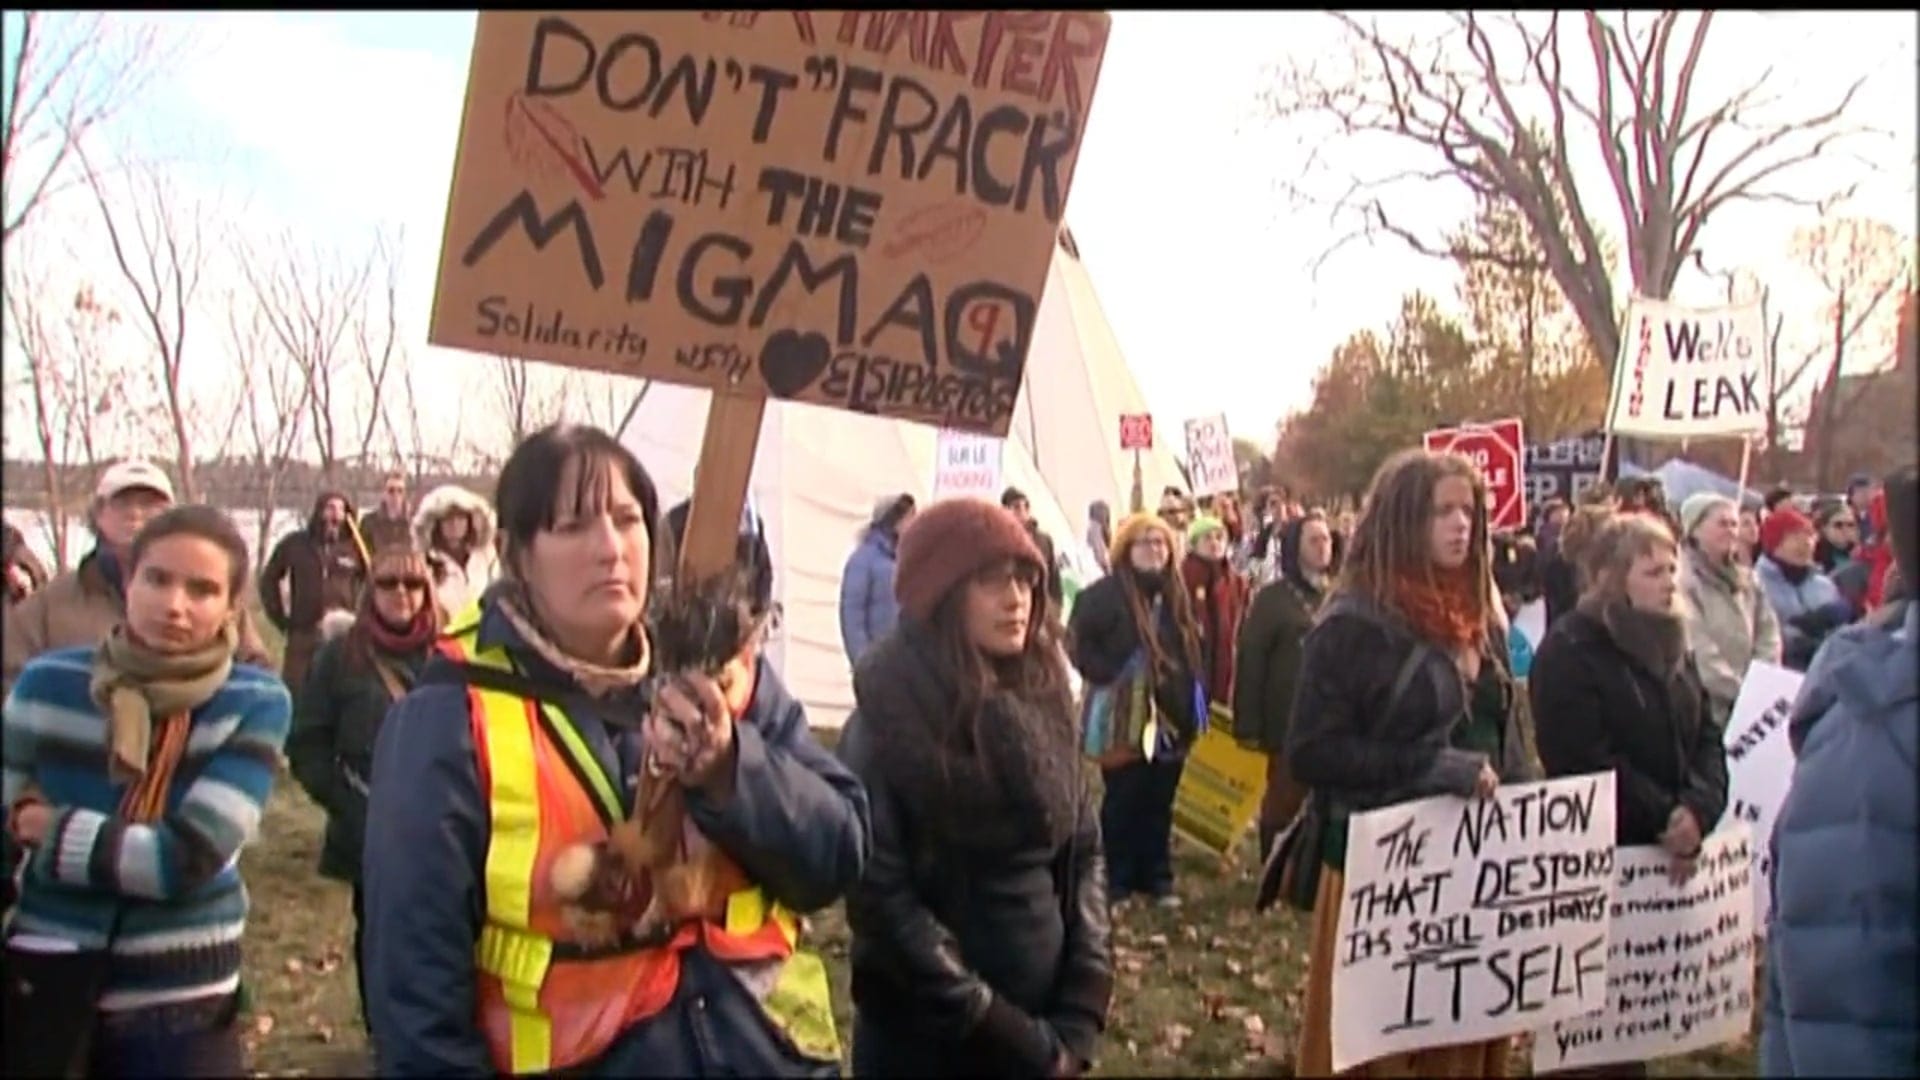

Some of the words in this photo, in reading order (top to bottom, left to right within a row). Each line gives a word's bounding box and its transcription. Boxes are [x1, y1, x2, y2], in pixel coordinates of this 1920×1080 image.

[524, 17, 799, 144] DON'T
[757, 166, 884, 250] THE
[476, 295, 648, 364] Solidarity
[1664, 368, 1760, 420] LEAK
[1728, 697, 1790, 762] WATER
[1351, 870, 1452, 927] THAT
[1618, 864, 1667, 888] you
[1404, 912, 1482, 952] SOIL
[1381, 936, 1604, 1035] ITSELF
[1556, 1024, 1603, 1062] you
